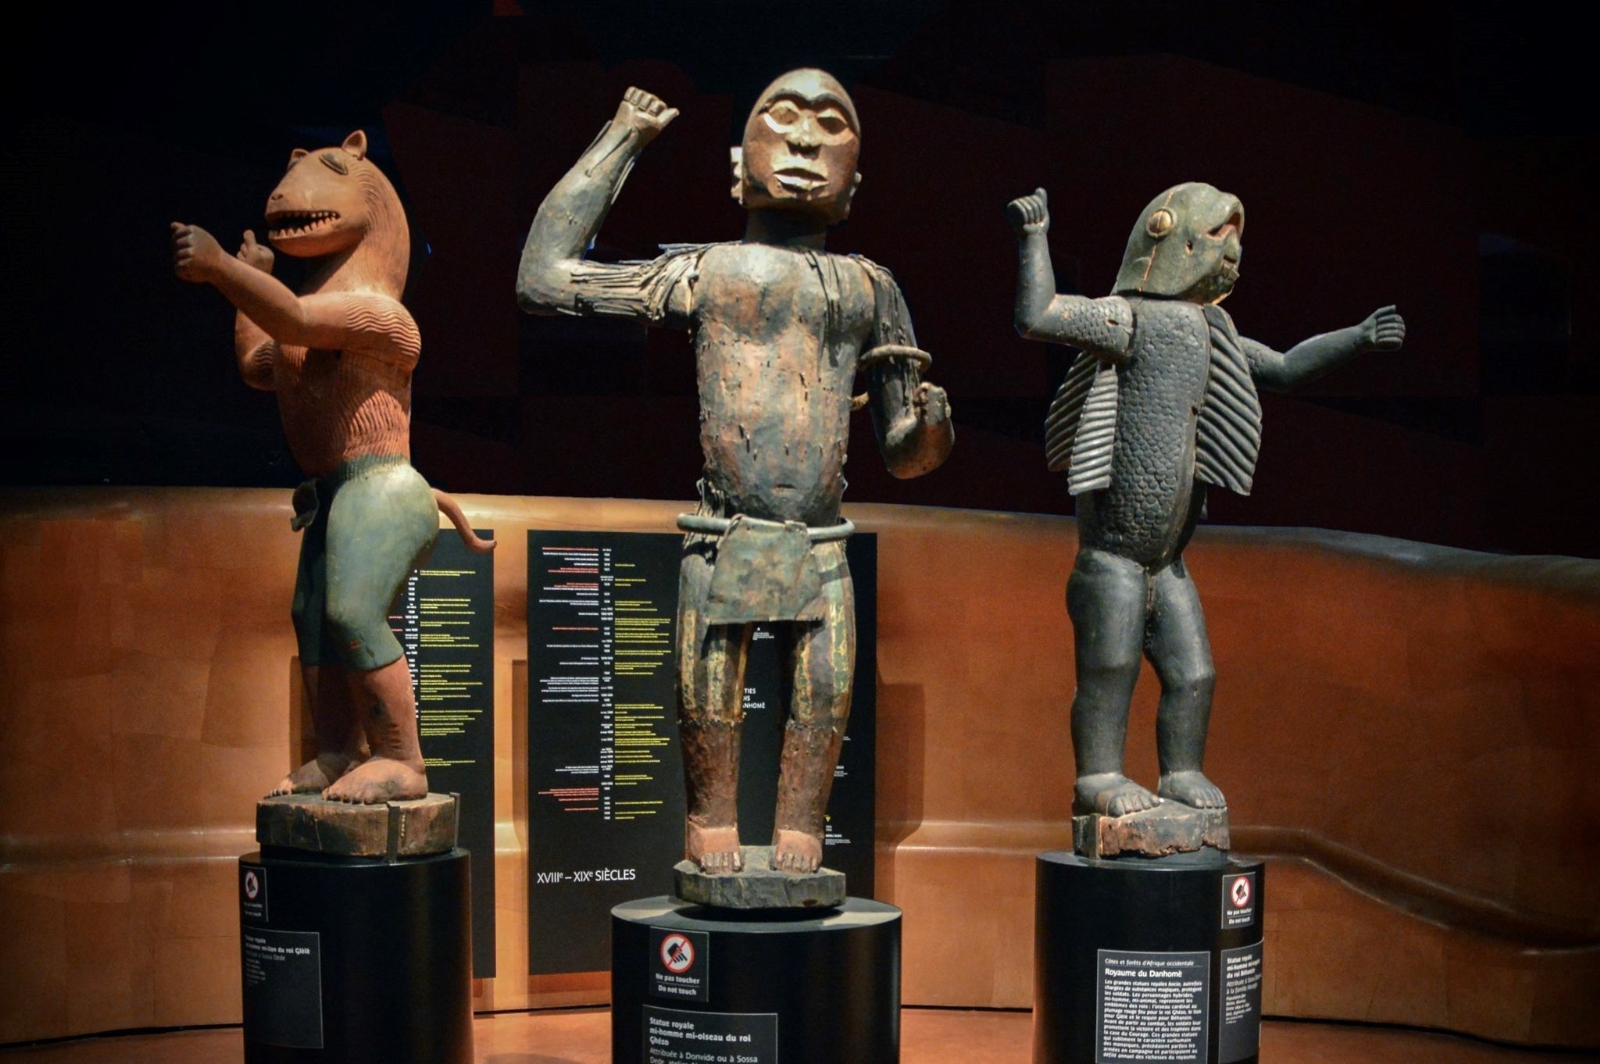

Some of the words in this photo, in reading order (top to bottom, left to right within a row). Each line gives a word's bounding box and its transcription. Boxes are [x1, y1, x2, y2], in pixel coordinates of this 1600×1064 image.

[595, 868, 636, 882] SIÈCLES
[1105, 968, 1136, 977] Royaume
[676, 976, 700, 984] toucher
[650, 1017, 670, 1028] Statue
[672, 1022, 694, 1032] royale
[650, 1028, 683, 1038] mi-homme
[686, 1032, 723, 1042] mi-oiseau
[726, 1034, 736, 1042] du
[739, 1034, 751, 1042] roi
[686, 1052, 714, 1062] Donvide
[730, 1054, 734, 1063] à
